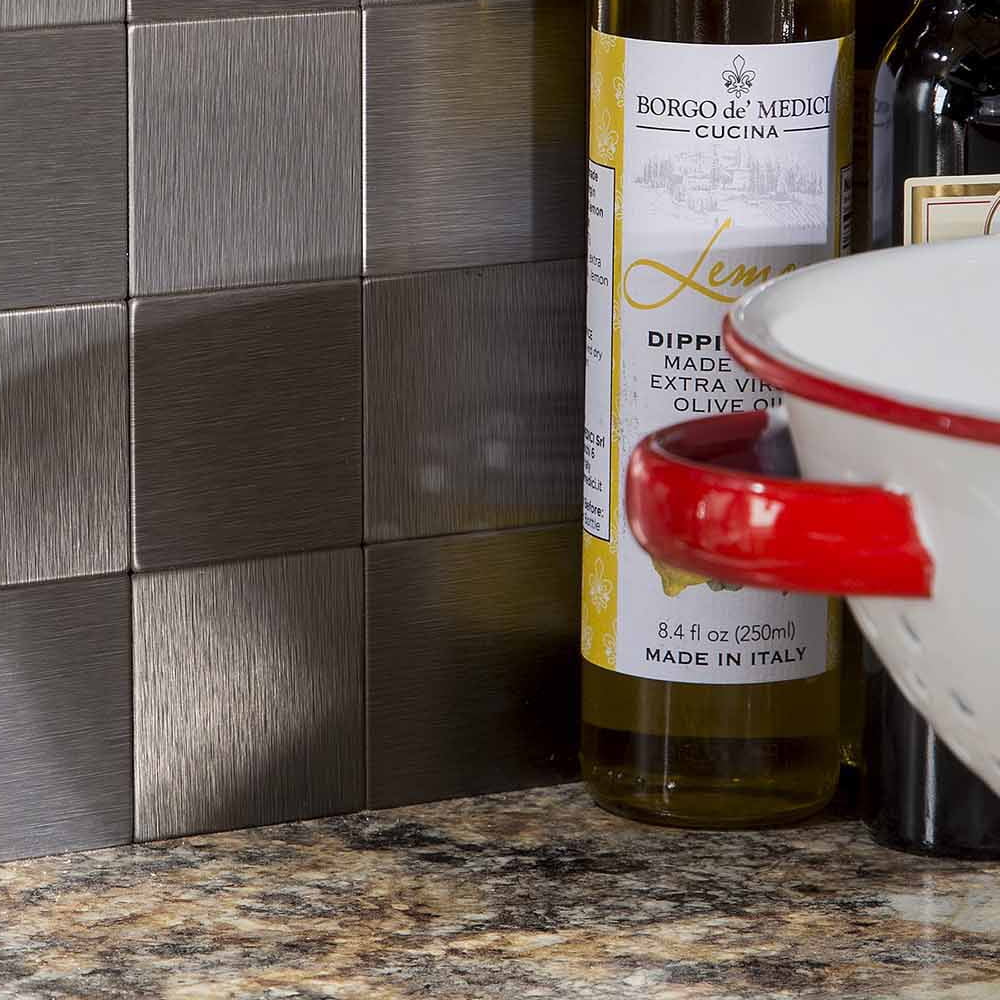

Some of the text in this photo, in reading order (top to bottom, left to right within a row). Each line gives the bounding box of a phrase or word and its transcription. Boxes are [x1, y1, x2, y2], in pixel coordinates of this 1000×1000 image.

[636, 95, 831, 119] BORGO de' MEDICI
[695, 125, 780, 139] CUCINA
[648, 330, 721, 352] DIPPI
[664, 354, 732, 373] MADE
[650, 374, 779, 393] EXTRA VIR
[673, 397, 745, 413] OLIVE
[657, 621, 796, 645] 8.4 fl oz (250ml)
[645, 646, 807, 667] MADE IN ITALY
